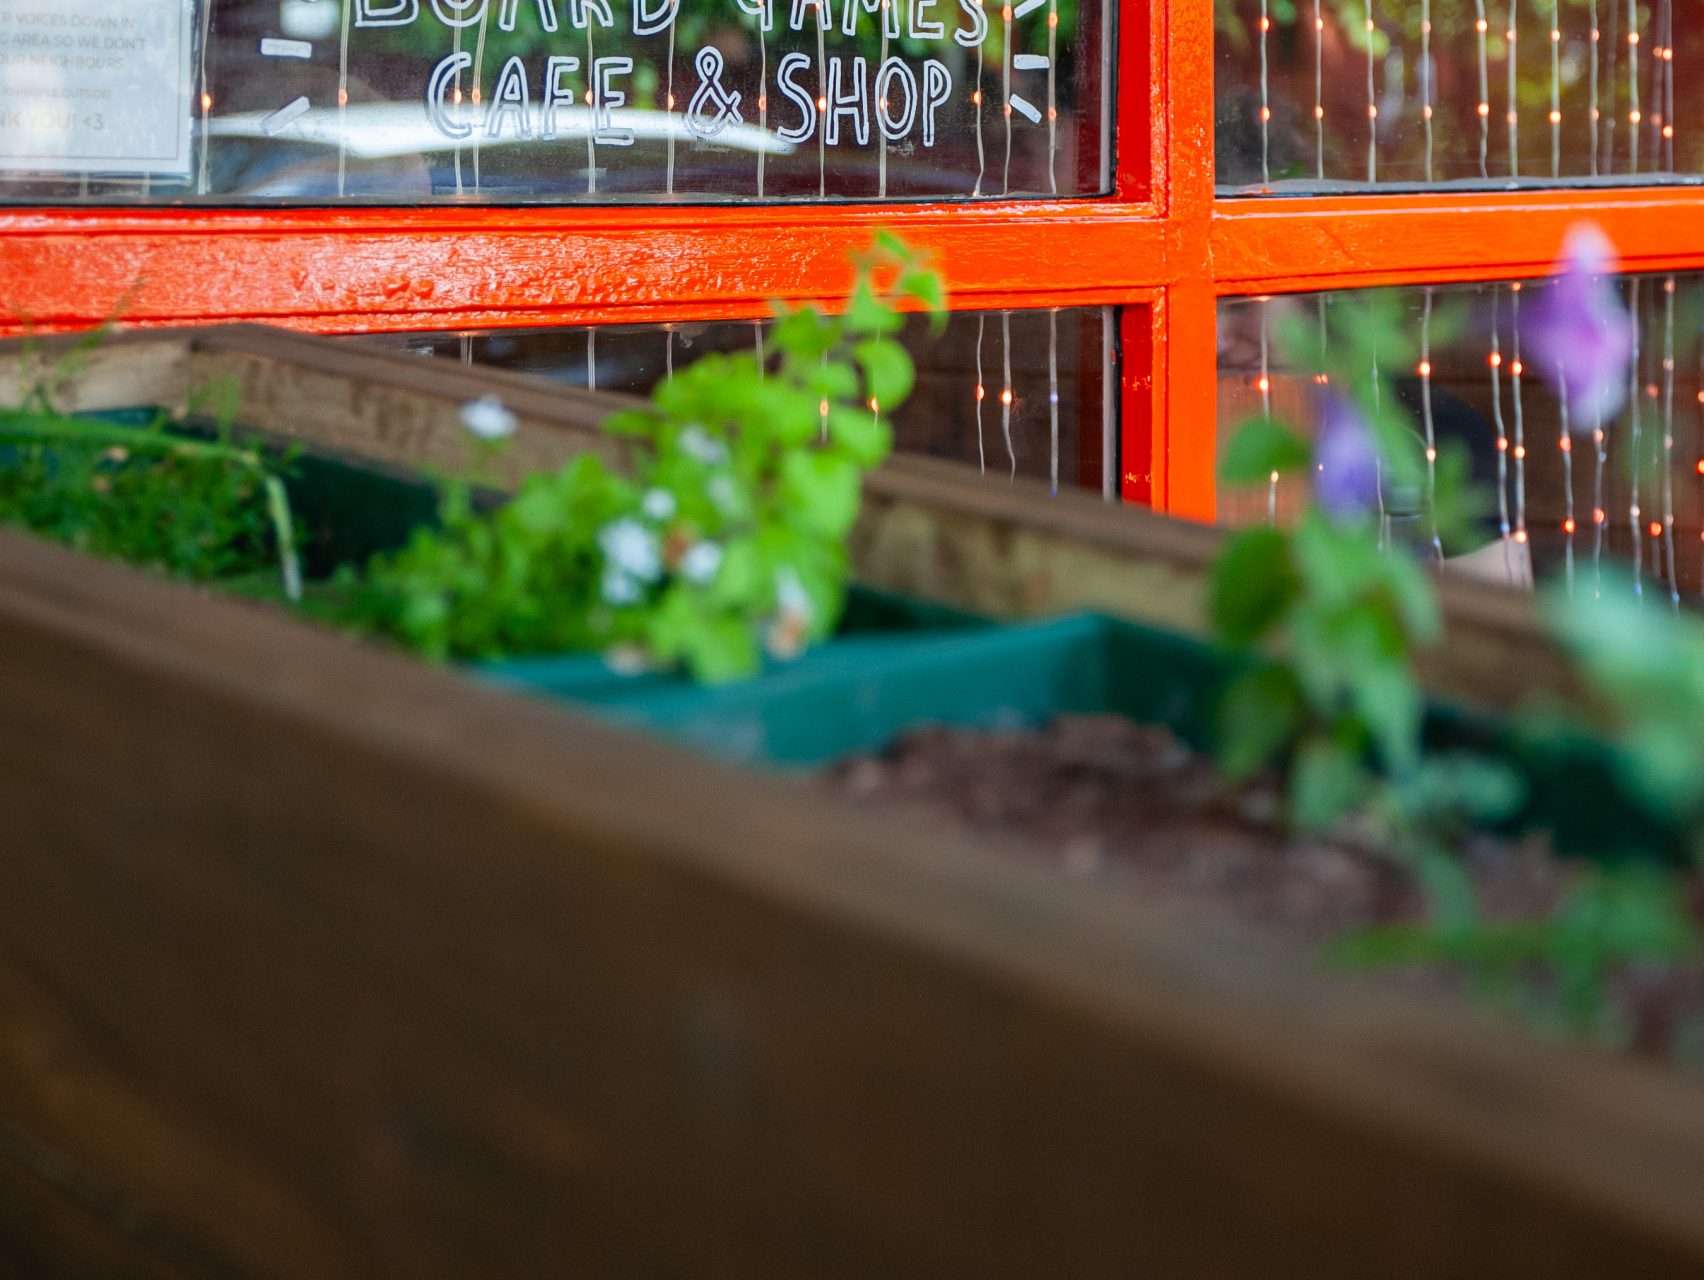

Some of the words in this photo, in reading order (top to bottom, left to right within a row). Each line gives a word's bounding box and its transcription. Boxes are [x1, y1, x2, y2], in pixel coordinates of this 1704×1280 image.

[16, 13, 66, 27] VOICES
[71, 14, 116, 29] DOWN
[12, 34, 50, 47] AREA
[54, 35, 73, 48] SO
[78, 36, 101, 49] WE
[104, 37, 147, 50] DON'T
[30, 55, 124, 70] NEIGHBOURS
[426, 51, 634, 146] CAFE
[687, 45, 743, 135] &
[776, 52, 953, 147] SHOP
